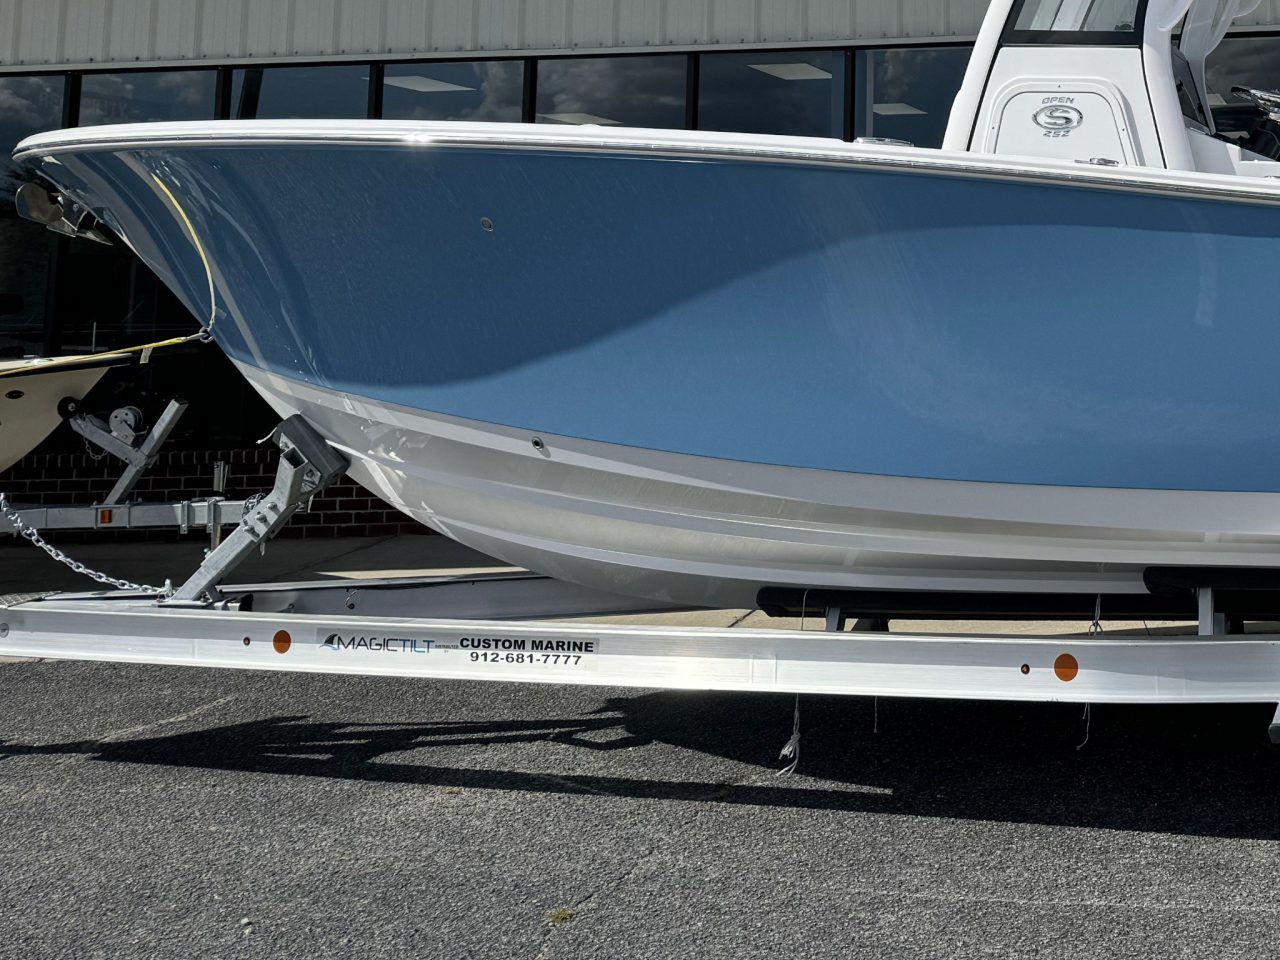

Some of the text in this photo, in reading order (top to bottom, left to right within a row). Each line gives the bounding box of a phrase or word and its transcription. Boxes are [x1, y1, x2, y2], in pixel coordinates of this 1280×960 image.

[337, 635, 435, 654] MAGICTILT
[459, 637, 526, 651] CUSTOM
[530, 639, 595, 653] MARINE
[469, 651, 582, 666] 912-681-7777
